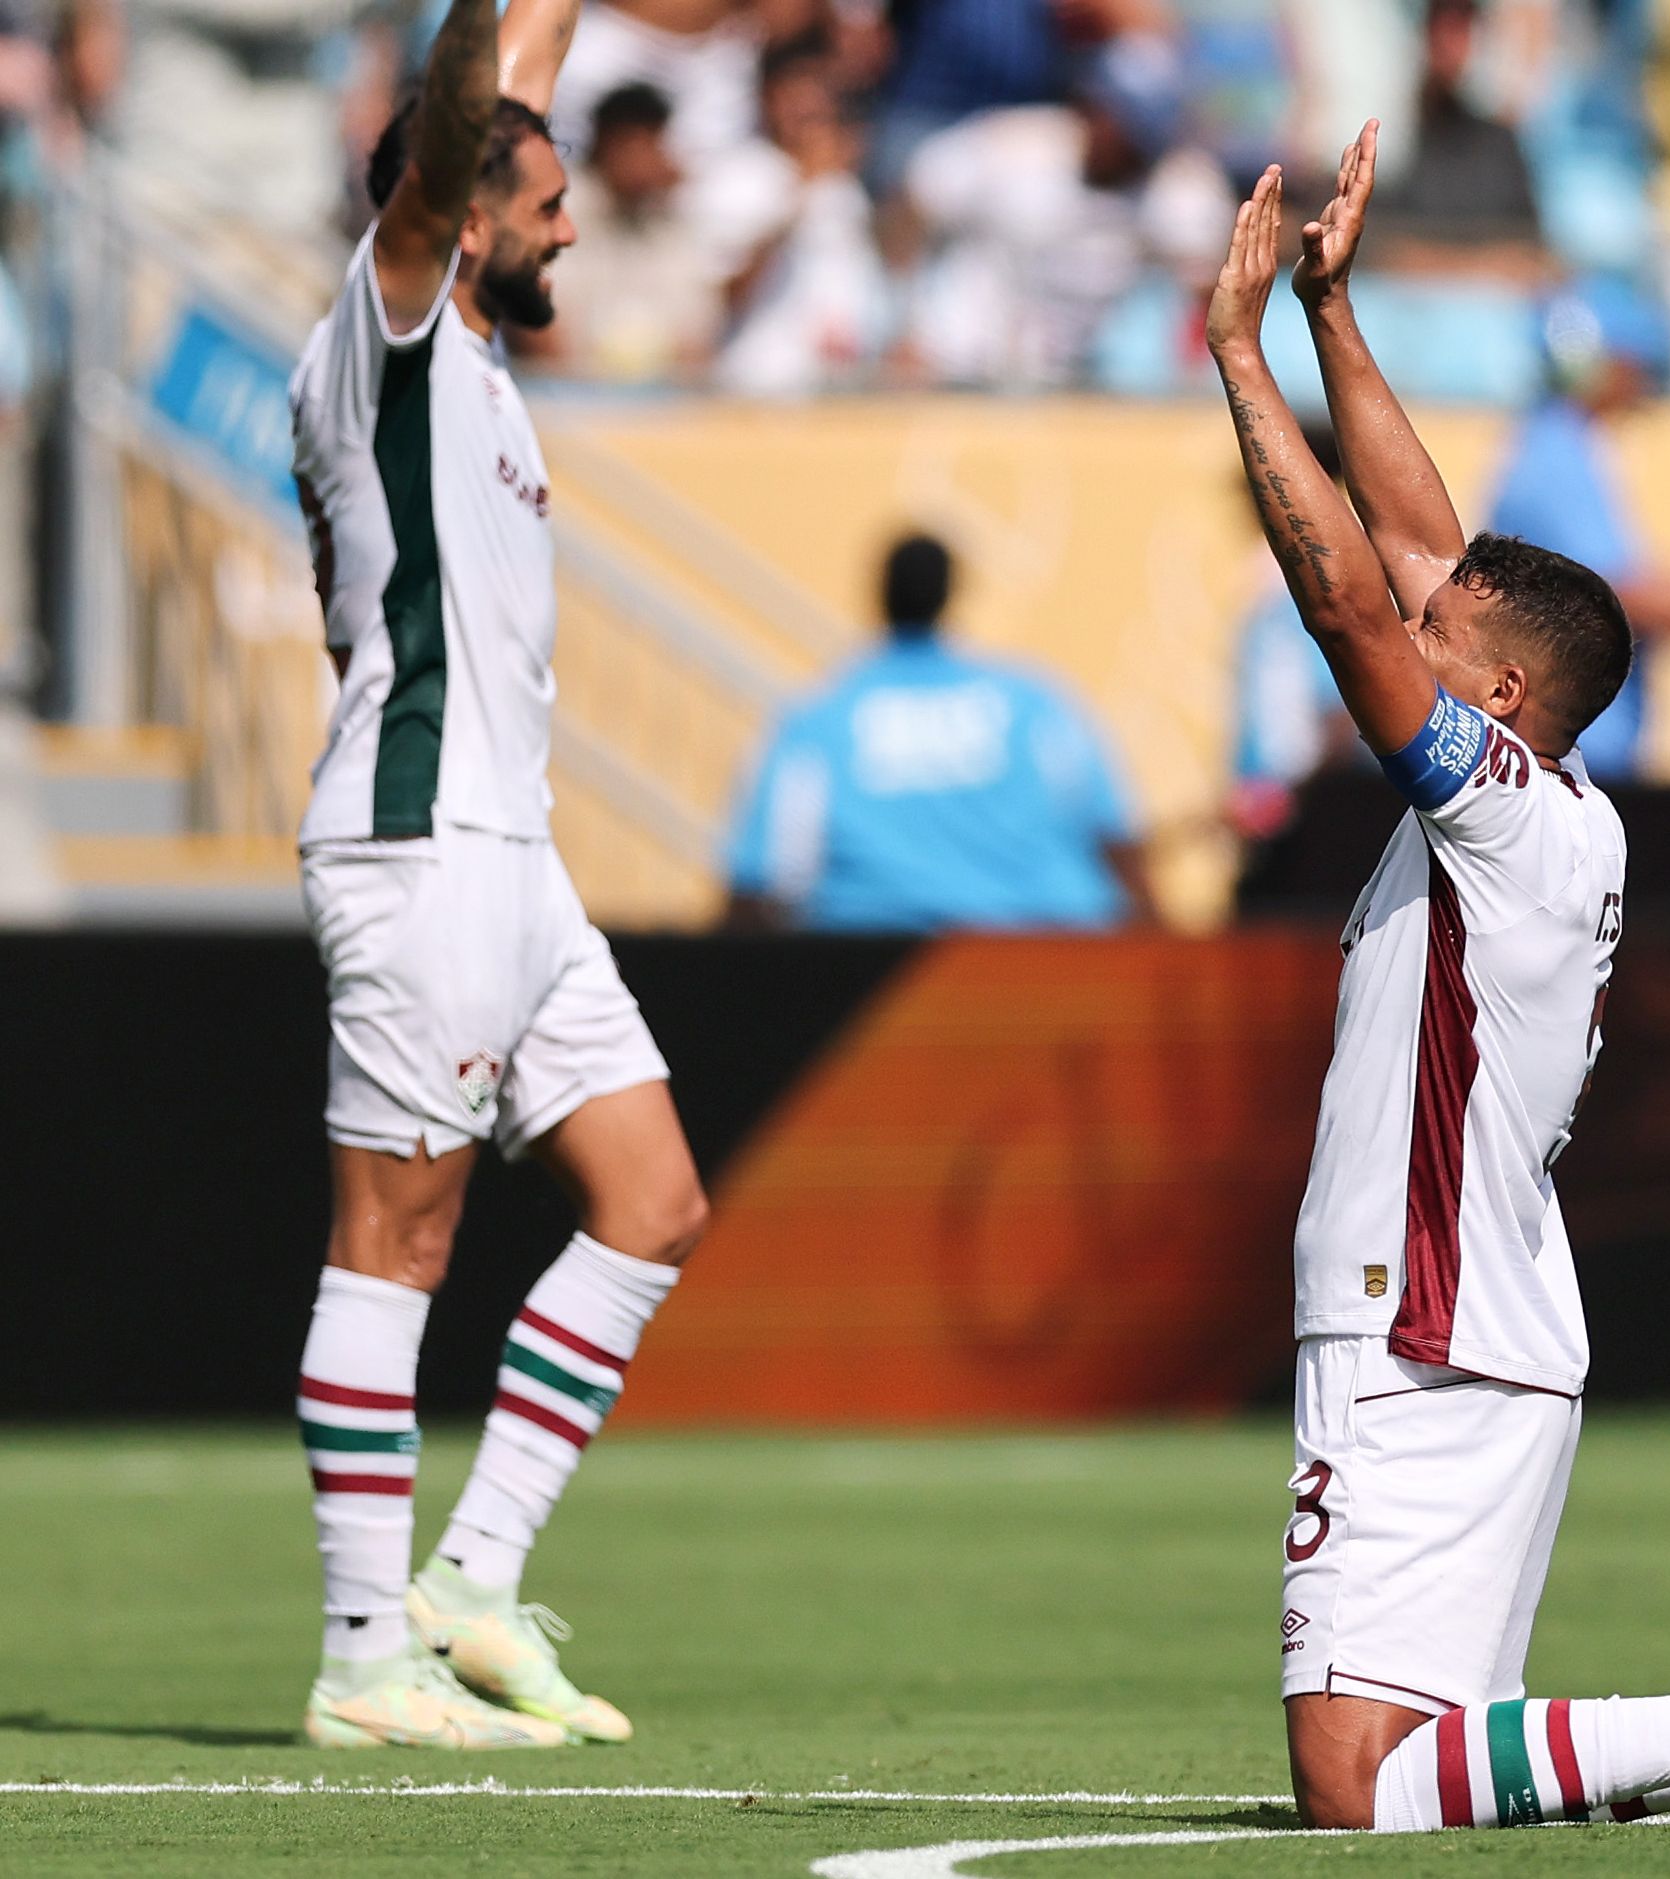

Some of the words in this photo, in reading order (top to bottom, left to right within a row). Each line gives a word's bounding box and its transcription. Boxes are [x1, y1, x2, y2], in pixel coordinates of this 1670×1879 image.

[1425, 715, 1456, 763] World
[1440, 706, 1471, 771] UNITES
[1452, 715, 1481, 777] FOOTBALL
[1285, 1459, 1333, 1563] 3
[1281, 1639, 1305, 1656] bro
